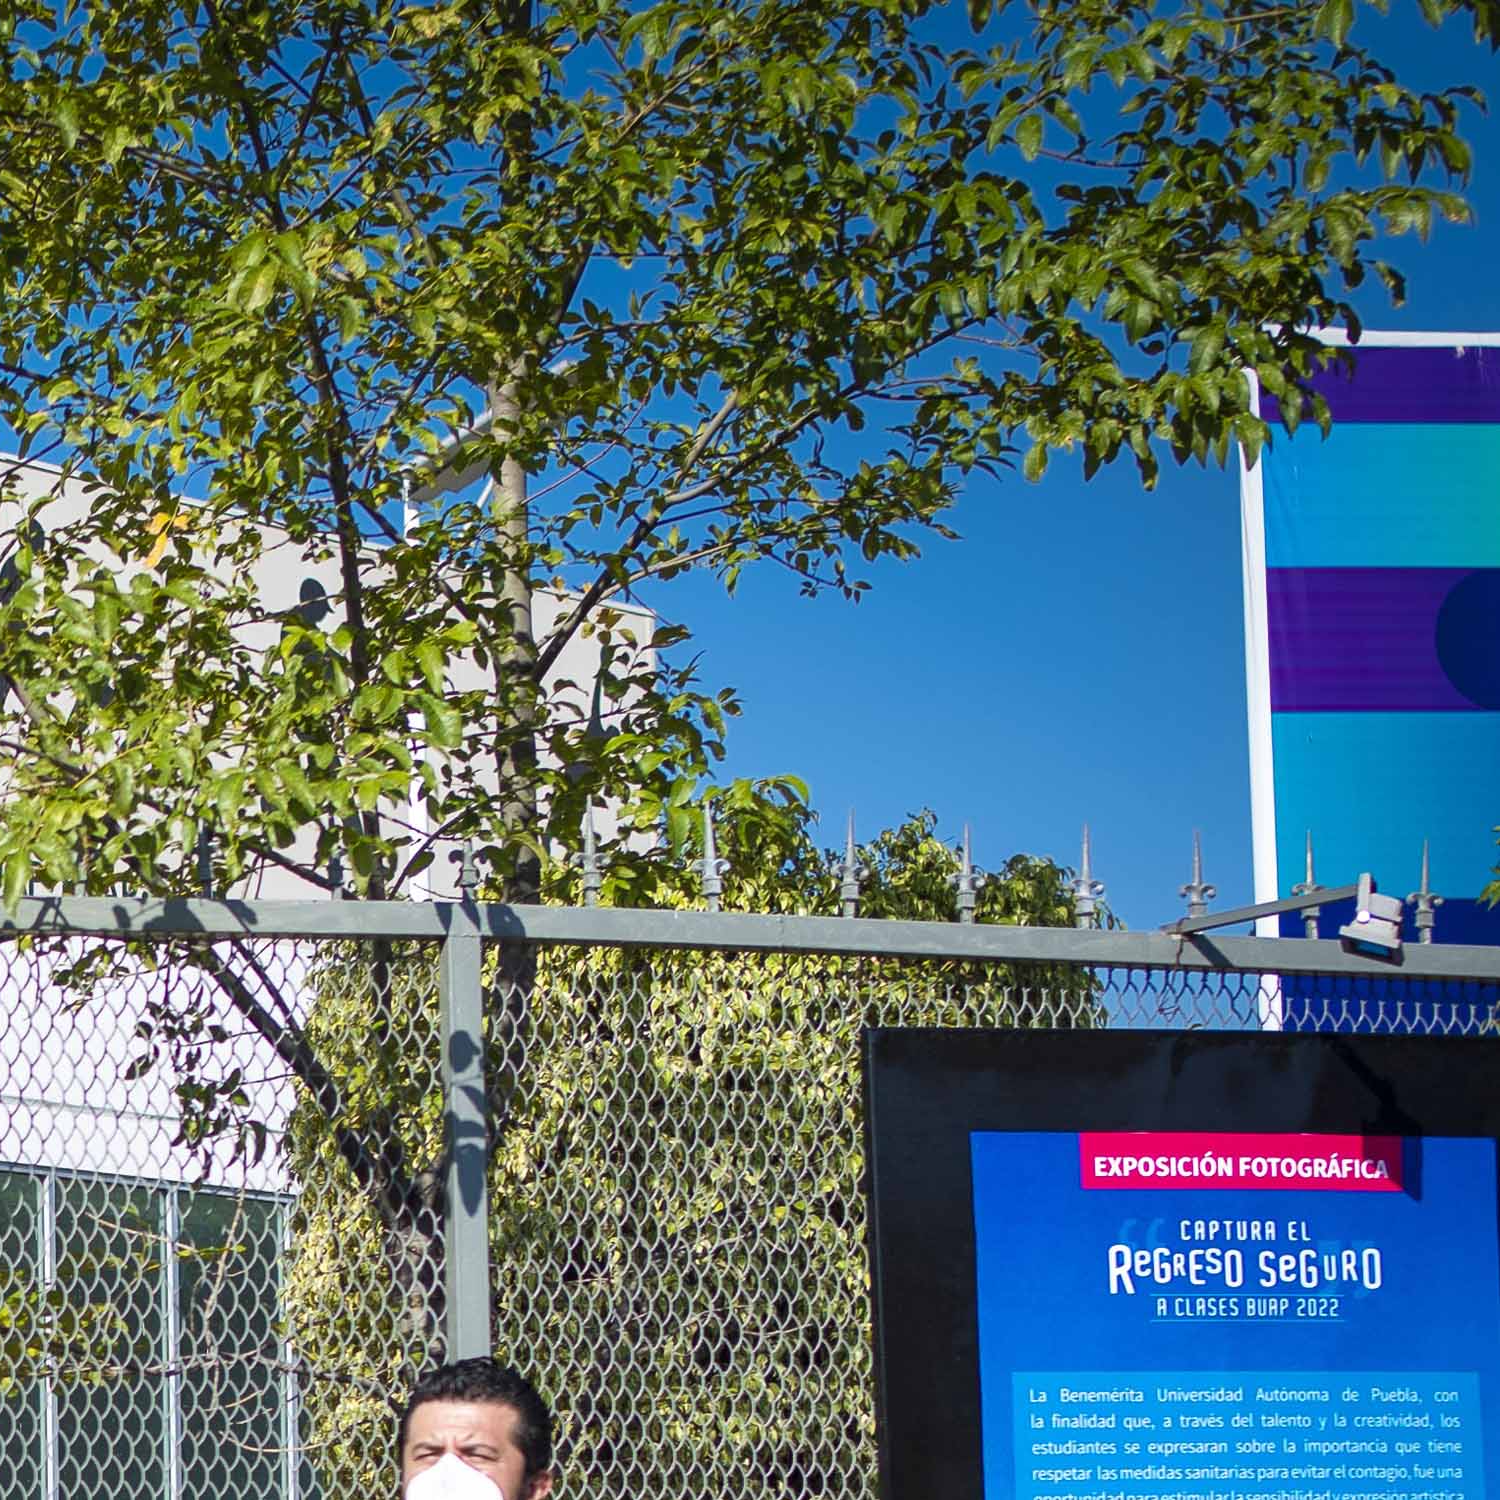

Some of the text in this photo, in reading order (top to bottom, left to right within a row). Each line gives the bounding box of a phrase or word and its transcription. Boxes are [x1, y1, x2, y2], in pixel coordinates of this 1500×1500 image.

[1094, 1151, 1389, 1179] EXPOSICIÓN FOTOGRÁFICA
[1180, 1220, 1311, 1241] CAPTURA EL
[1156, 1298, 1339, 1317] A CLASES BUAP 2022
[1030, 1387, 1458, 1405] La Benemérita Universidad Autónoma de Puebla, con
[1031, 1414, 1460, 1431] la finalidad que, a través del talento y la creatividad, los
[1032, 1439, 1462, 1457] estudiantes se expresaran sobre la importancia que tiene
[1033, 1466, 1091, 1483] respetar
[1098, 1466, 1117, 1480] las
[1120, 1466, 1182, 1480] medidas
[1185, 1465, 1254, 1480] sanitarias
[1257, 1468, 1288, 1483] para
[1291, 1465, 1331, 1479] evitar
[1334, 1465, 1345, 1479] el
[1414, 1464, 1434, 1479] fue
[1437, 1468, 1462, 1479] una
